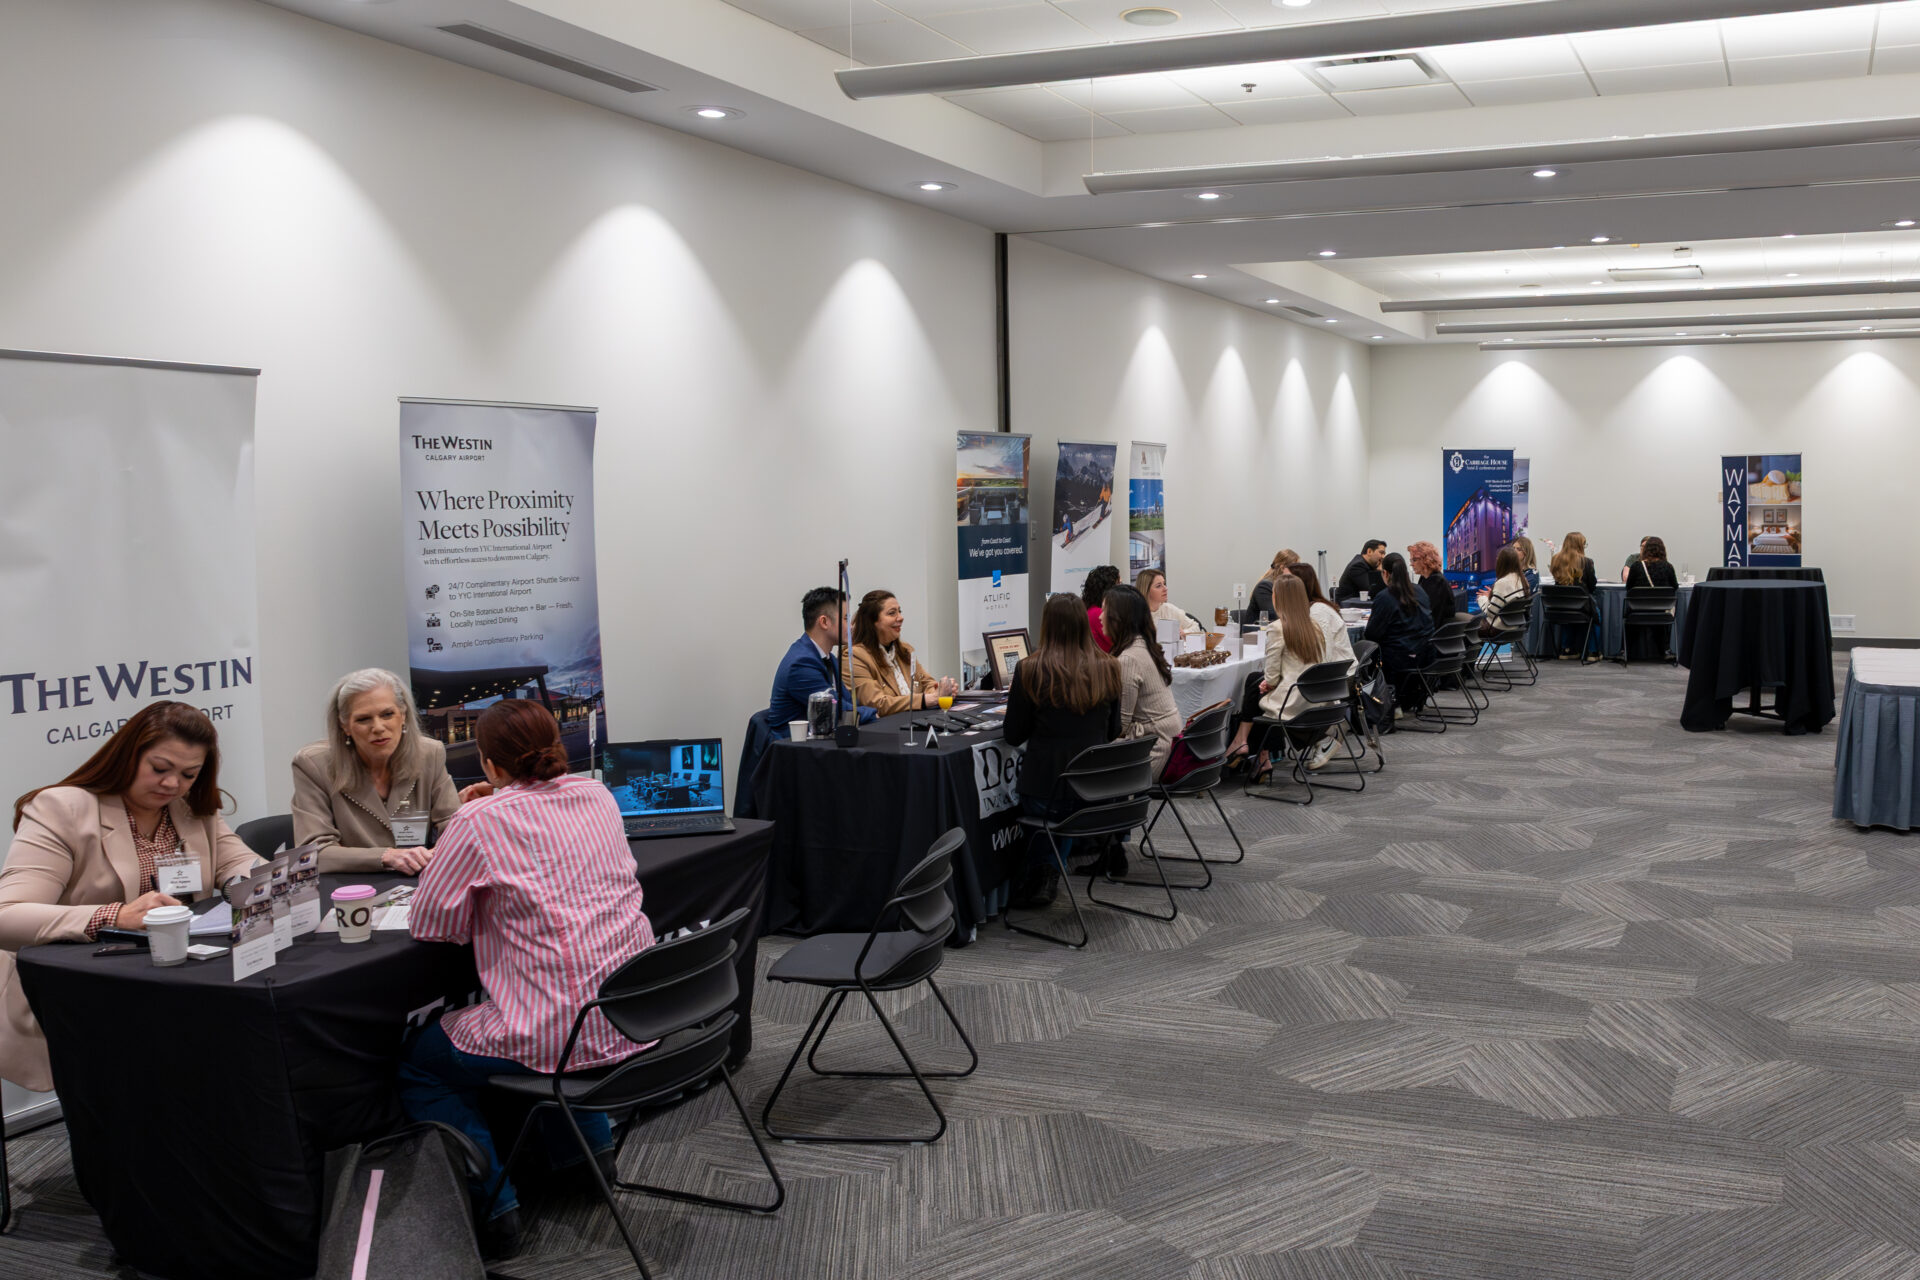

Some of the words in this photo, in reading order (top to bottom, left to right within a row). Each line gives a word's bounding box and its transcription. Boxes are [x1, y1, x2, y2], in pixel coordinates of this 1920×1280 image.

[412, 435, 440, 449] THE
[441, 436, 492, 450] WESTIN
[416, 490, 485, 510] Where
[488, 490, 574, 515] Proximity
[418, 520, 479, 540] Meets
[482, 517, 570, 542] Possibility
[422, 548, 436, 556] Just
[492, 544, 530, 552] International
[531, 543, 552, 551] Airport
[985, 549, 994, 558] got
[994, 549, 1003, 557] you
[423, 557, 440, 565] with
[440, 556, 471, 565] effortless
[492, 554, 525, 562] downtown
[526, 553, 550, 561] Calgary.
[448, 582, 464, 590] 24/7
[465, 580, 510, 589] Complimentary
[511, 578, 534, 586] Airport
[473, 590, 508, 598] International
[510, 588, 532, 596] Airport
[449, 609, 475, 618] On-Site
[505, 604, 528, 613] Kitchen
[450, 620, 473, 628] Locally
[475, 618, 497, 627] Inspired
[498, 616, 518, 624] Dining
[451, 640, 473, 649] Ample
[474, 636, 519, 647] Complimentary
[520, 633, 544, 641] Parking
[0, 672, 94, 715] THE
[96, 656, 252, 702] WESTIN
[46, 718, 131, 745] CALGAR
